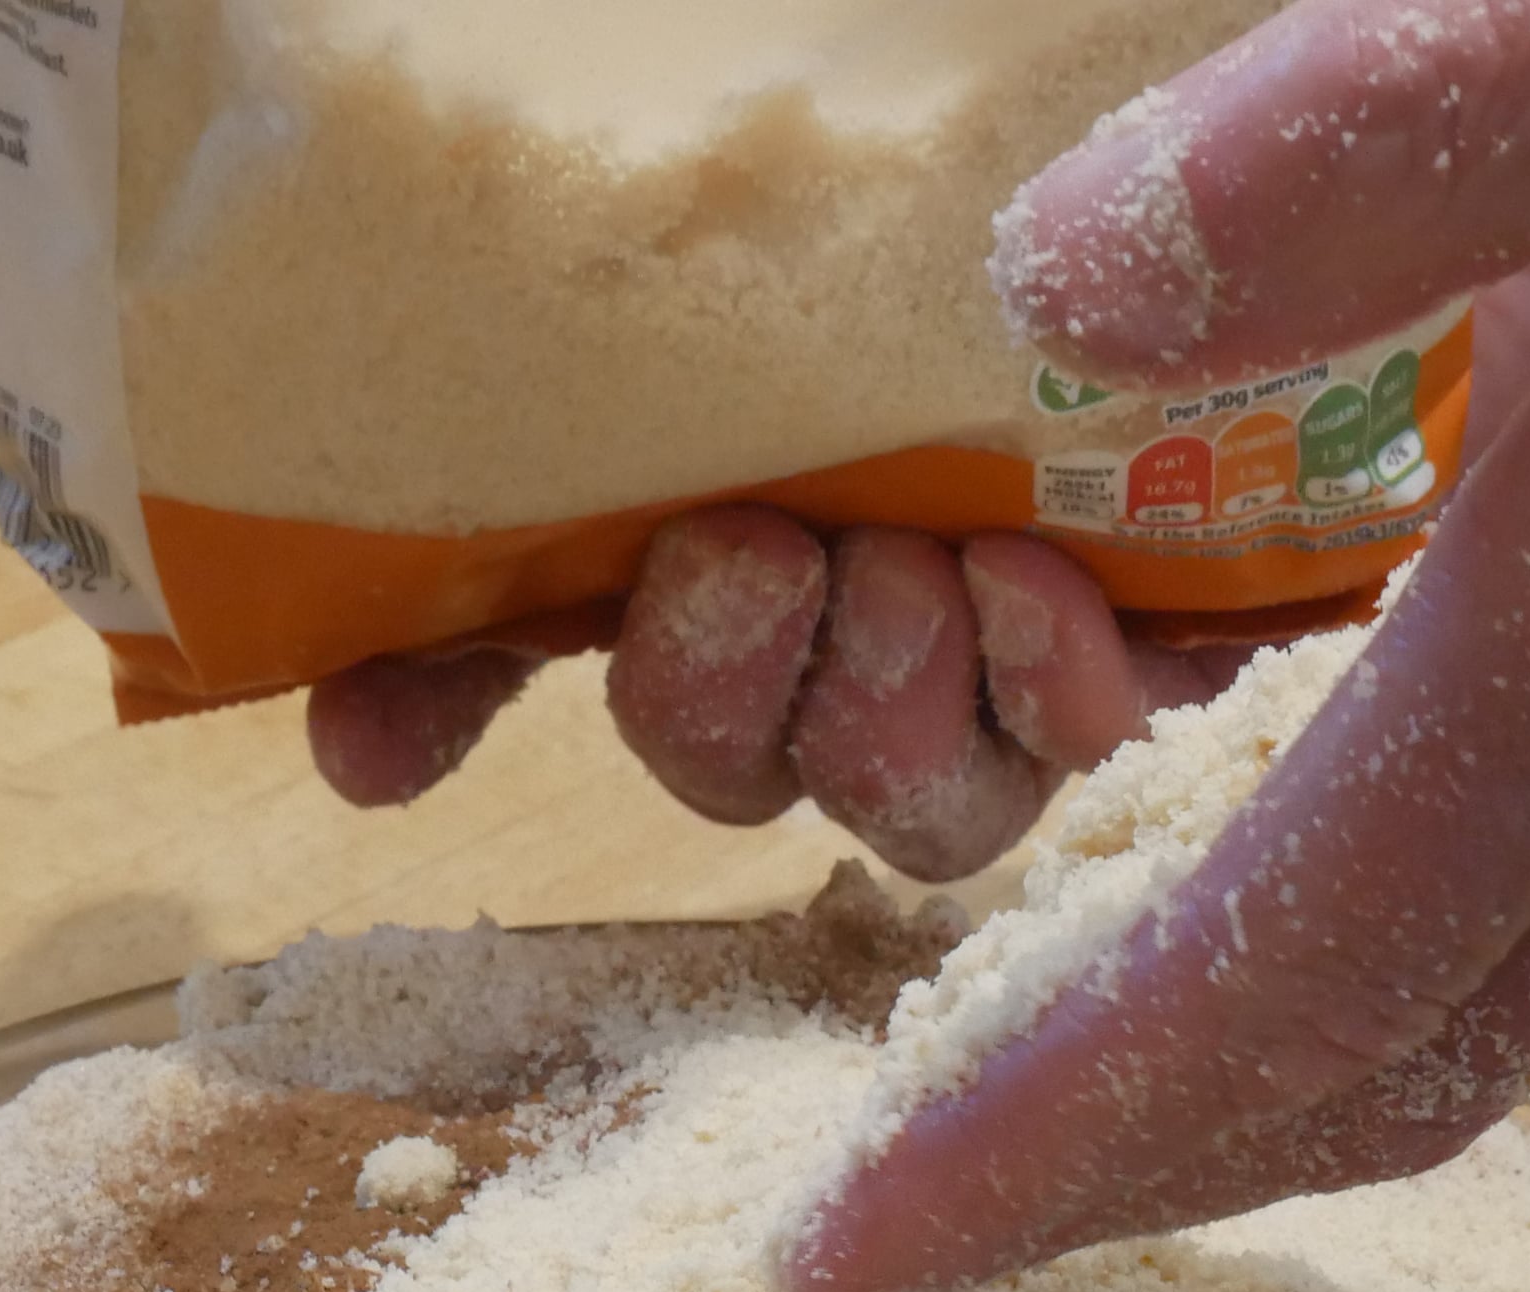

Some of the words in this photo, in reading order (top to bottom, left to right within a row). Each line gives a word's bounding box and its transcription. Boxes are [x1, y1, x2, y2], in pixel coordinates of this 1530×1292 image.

[1165, 403, 1203, 426] Per
[1207, 382, 1249, 413] 30g
[1252, 362, 1329, 400] serving
[1305, 402, 1364, 437] SUGARS
[1155, 454, 1186, 471] FAT
[1202, 510, 1303, 540] Reference
[1310, 501, 1386, 526] Intakes
